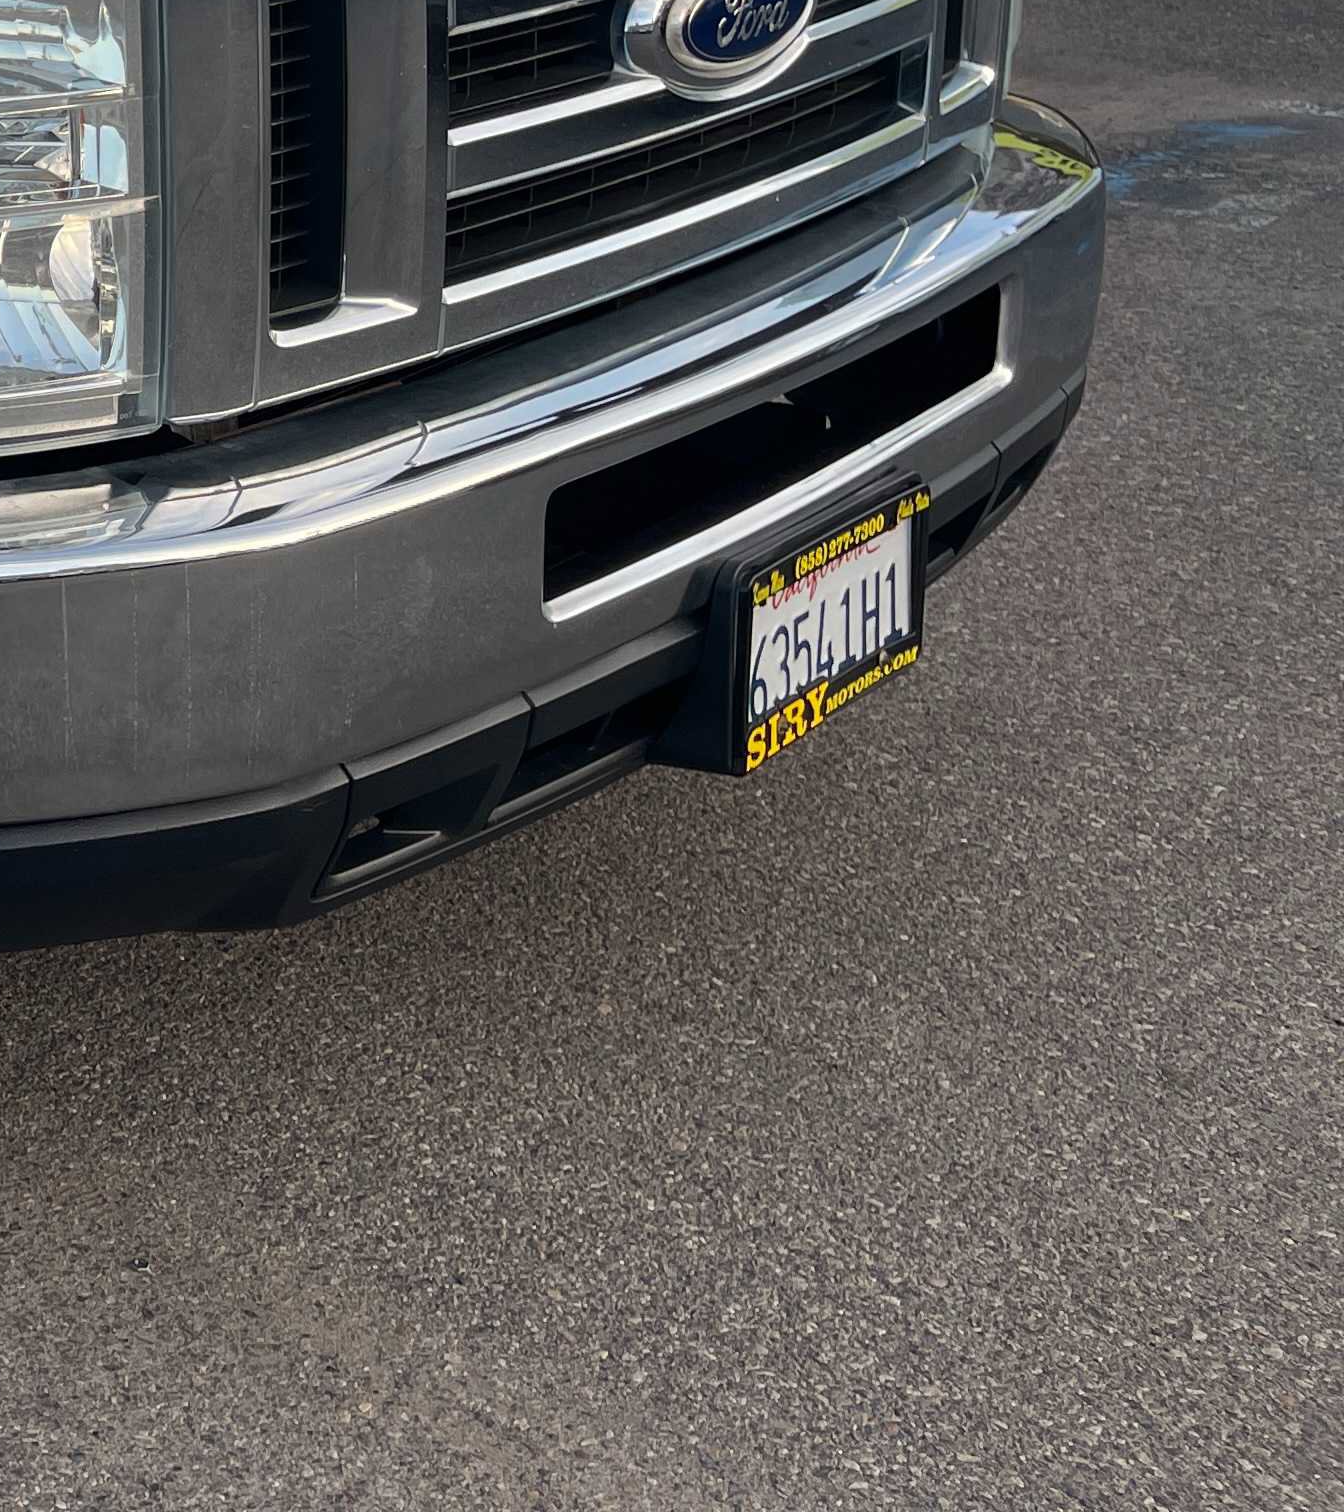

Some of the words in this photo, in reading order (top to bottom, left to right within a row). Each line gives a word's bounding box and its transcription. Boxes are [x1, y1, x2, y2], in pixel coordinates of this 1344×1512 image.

[746, 681, 829, 772] SIRY
[826, 646, 919, 714] MOTORS.COM
[750, 562, 904, 717] 63541H1
